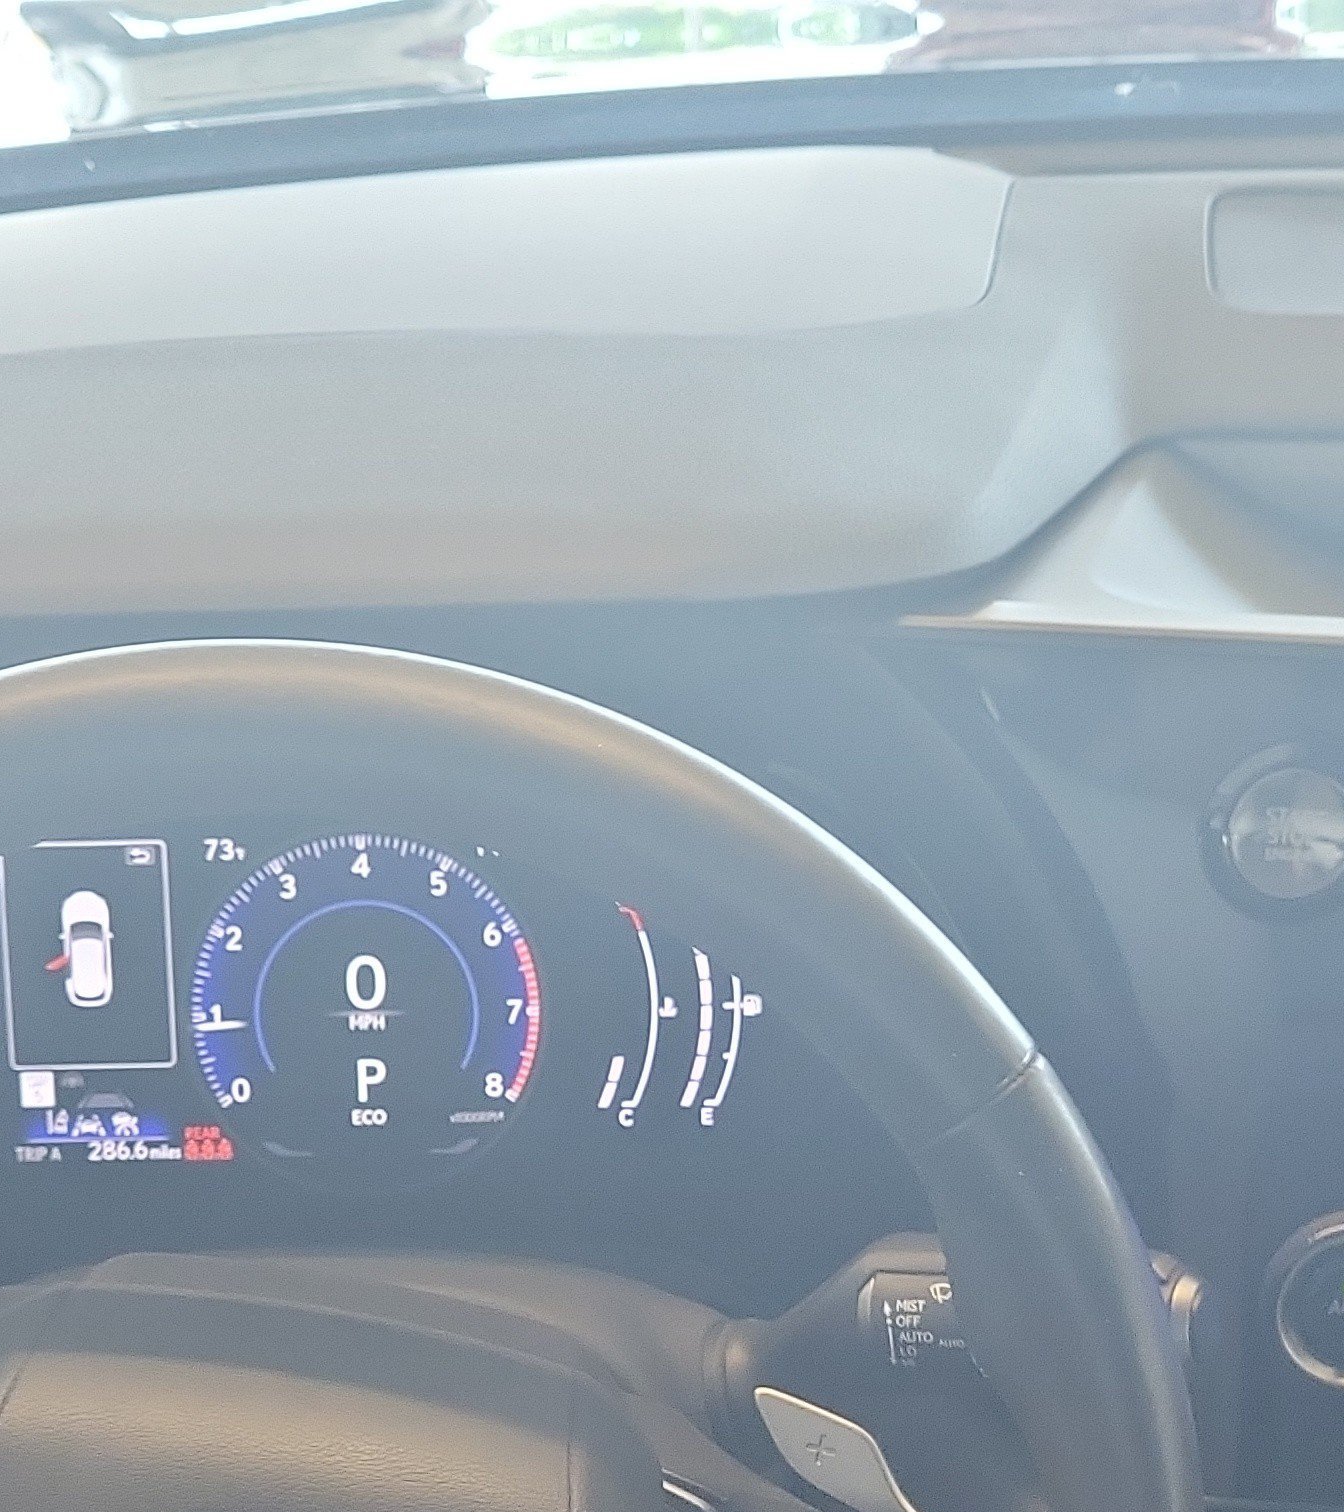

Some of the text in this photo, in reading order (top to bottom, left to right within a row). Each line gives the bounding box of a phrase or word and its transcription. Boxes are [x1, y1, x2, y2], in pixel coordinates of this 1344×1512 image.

[351, 852, 371, 878] 4
[279, 874, 297, 900] 3
[429, 871, 448, 897] 5
[225, 926, 243, 951] 2
[482, 922, 502, 947] 6
[346, 954, 387, 1011] 0
[209, 1003, 223, 1024] 1
[348, 1014, 387, 1031] MPH
[507, 998, 522, 1025] 7
[231, 1077, 251, 1103] 0
[356, 1058, 387, 1103] P
[484, 1072, 504, 1098] 8
[351, 1108, 388, 1126] ECO
[618, 1108, 635, 1127] C
[700, 1107, 715, 1126] E
[88, 1140, 148, 1162] 286.6
[896, 1300, 926, 1312] MIST
[896, 1315, 921, 1327] OFF
[899, 1331, 934, 1344] AUTO
